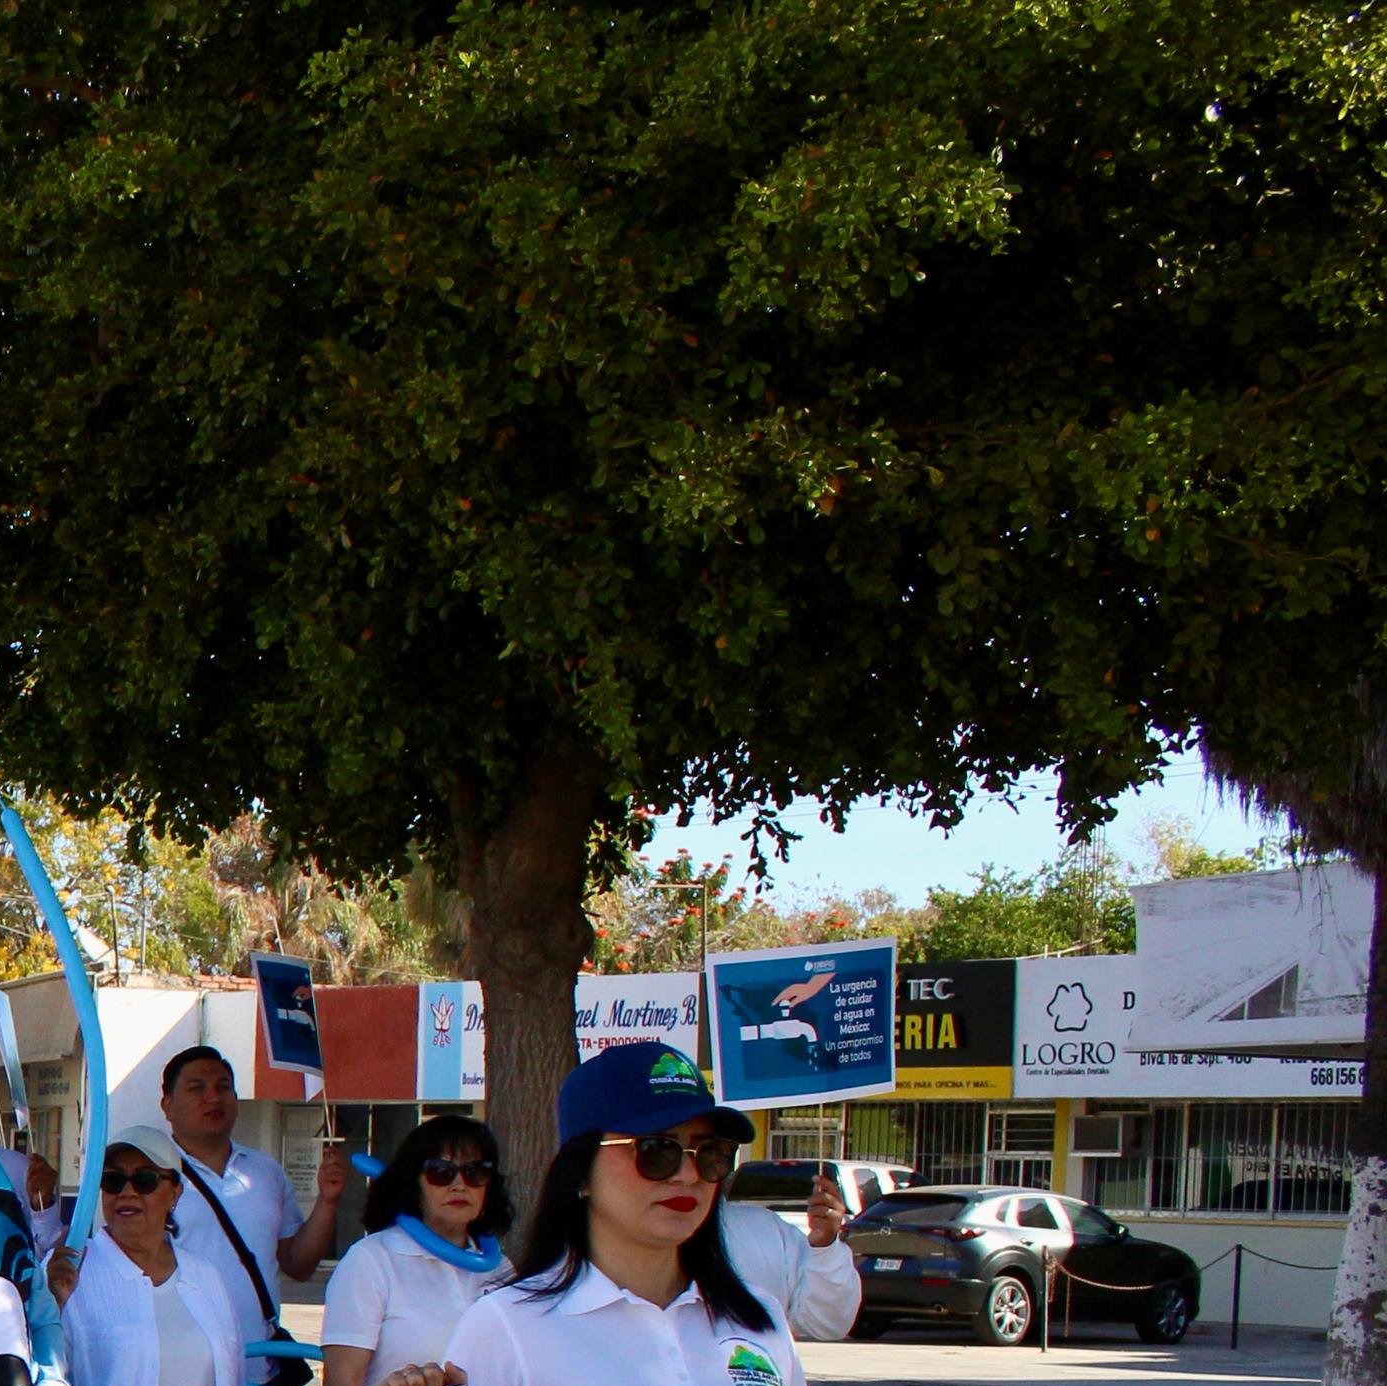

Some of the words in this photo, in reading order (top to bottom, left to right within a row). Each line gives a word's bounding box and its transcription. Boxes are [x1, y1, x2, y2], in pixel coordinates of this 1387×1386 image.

[829, 983, 841, 994] La
[842, 976, 878, 994] urgencia
[906, 977, 955, 1001] TEC
[835, 995, 847, 1007] de
[848, 992, 874, 1006] cuidar
[679, 992, 699, 1026] B.
[833, 1010, 842, 1022] el
[843, 1009, 864, 1023] agua
[865, 1006, 875, 1018] en
[839, 1022, 870, 1036] México:
[825, 1039, 836, 1051] Un
[837, 1034, 884, 1053] compromiso
[838, 1053, 848, 1064] de
[849, 1050, 872, 1063] todos
[1021, 1041, 1116, 1067] LOGRO
